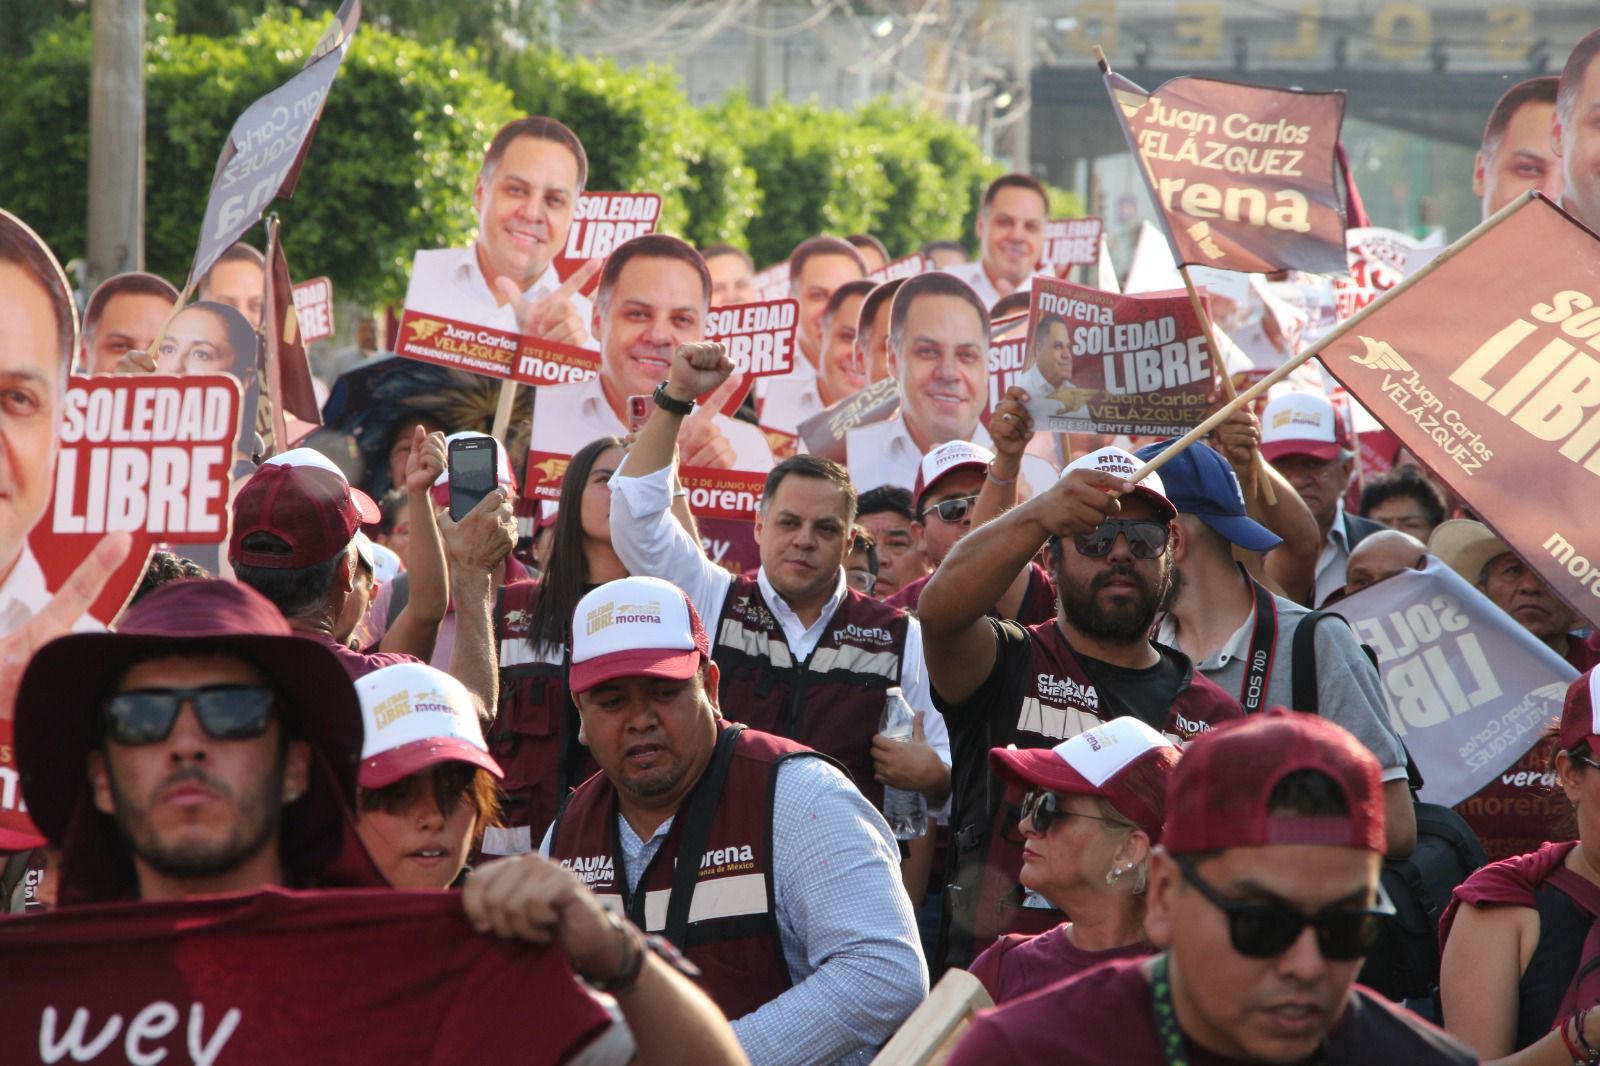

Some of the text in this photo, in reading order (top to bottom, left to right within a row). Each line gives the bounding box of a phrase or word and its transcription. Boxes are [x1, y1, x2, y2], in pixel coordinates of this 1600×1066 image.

[1144, 97, 1311, 144] Juan Carlos
[574, 196, 659, 221] SOLEDAD
[564, 221, 649, 260] LIBR
[1041, 238, 1097, 266] LIBRE
[300, 303, 330, 340] RE
[705, 303, 796, 337] SOLEDAD
[1039, 291, 1114, 326] morena
[1531, 290, 1600, 349] SO
[442, 323, 517, 352] Juan Carlos
[704, 330, 792, 376] BRE
[1072, 316, 1176, 357] SOLEDAD
[404, 343, 512, 375] PRESIDENTE MUNICIPAL
[988, 343, 1026, 373] SOL
[1103, 335, 1211, 396] LIBRE
[59, 387, 232, 443] SOLEDAD
[1147, 391, 1206, 406] Carlos
[1402, 369, 1494, 462] Juan Carlos
[1049, 419, 1210, 437] PRESIDENTE MUNICIP
[1380, 373, 1484, 476] VELÁZQUEZ
[1097, 454, 1134, 465] RITA
[53, 445, 225, 533] LIBRE
[680, 477, 690, 485] TE
[692, 479, 699, 487] 2
[701, 479, 713, 488] DE
[714, 481, 745, 490] JUNIO
[587, 612, 615, 636] LIBRE
[615, 614, 662, 625] morena
[833, 624, 893, 642] morena
[1246, 649, 1268, 709] EOS 70D
[374, 700, 412, 731] LIBRE
[717, 866, 726, 874] de
[727, 862, 755, 872] México
[38, 1000, 242, 1066] wey
